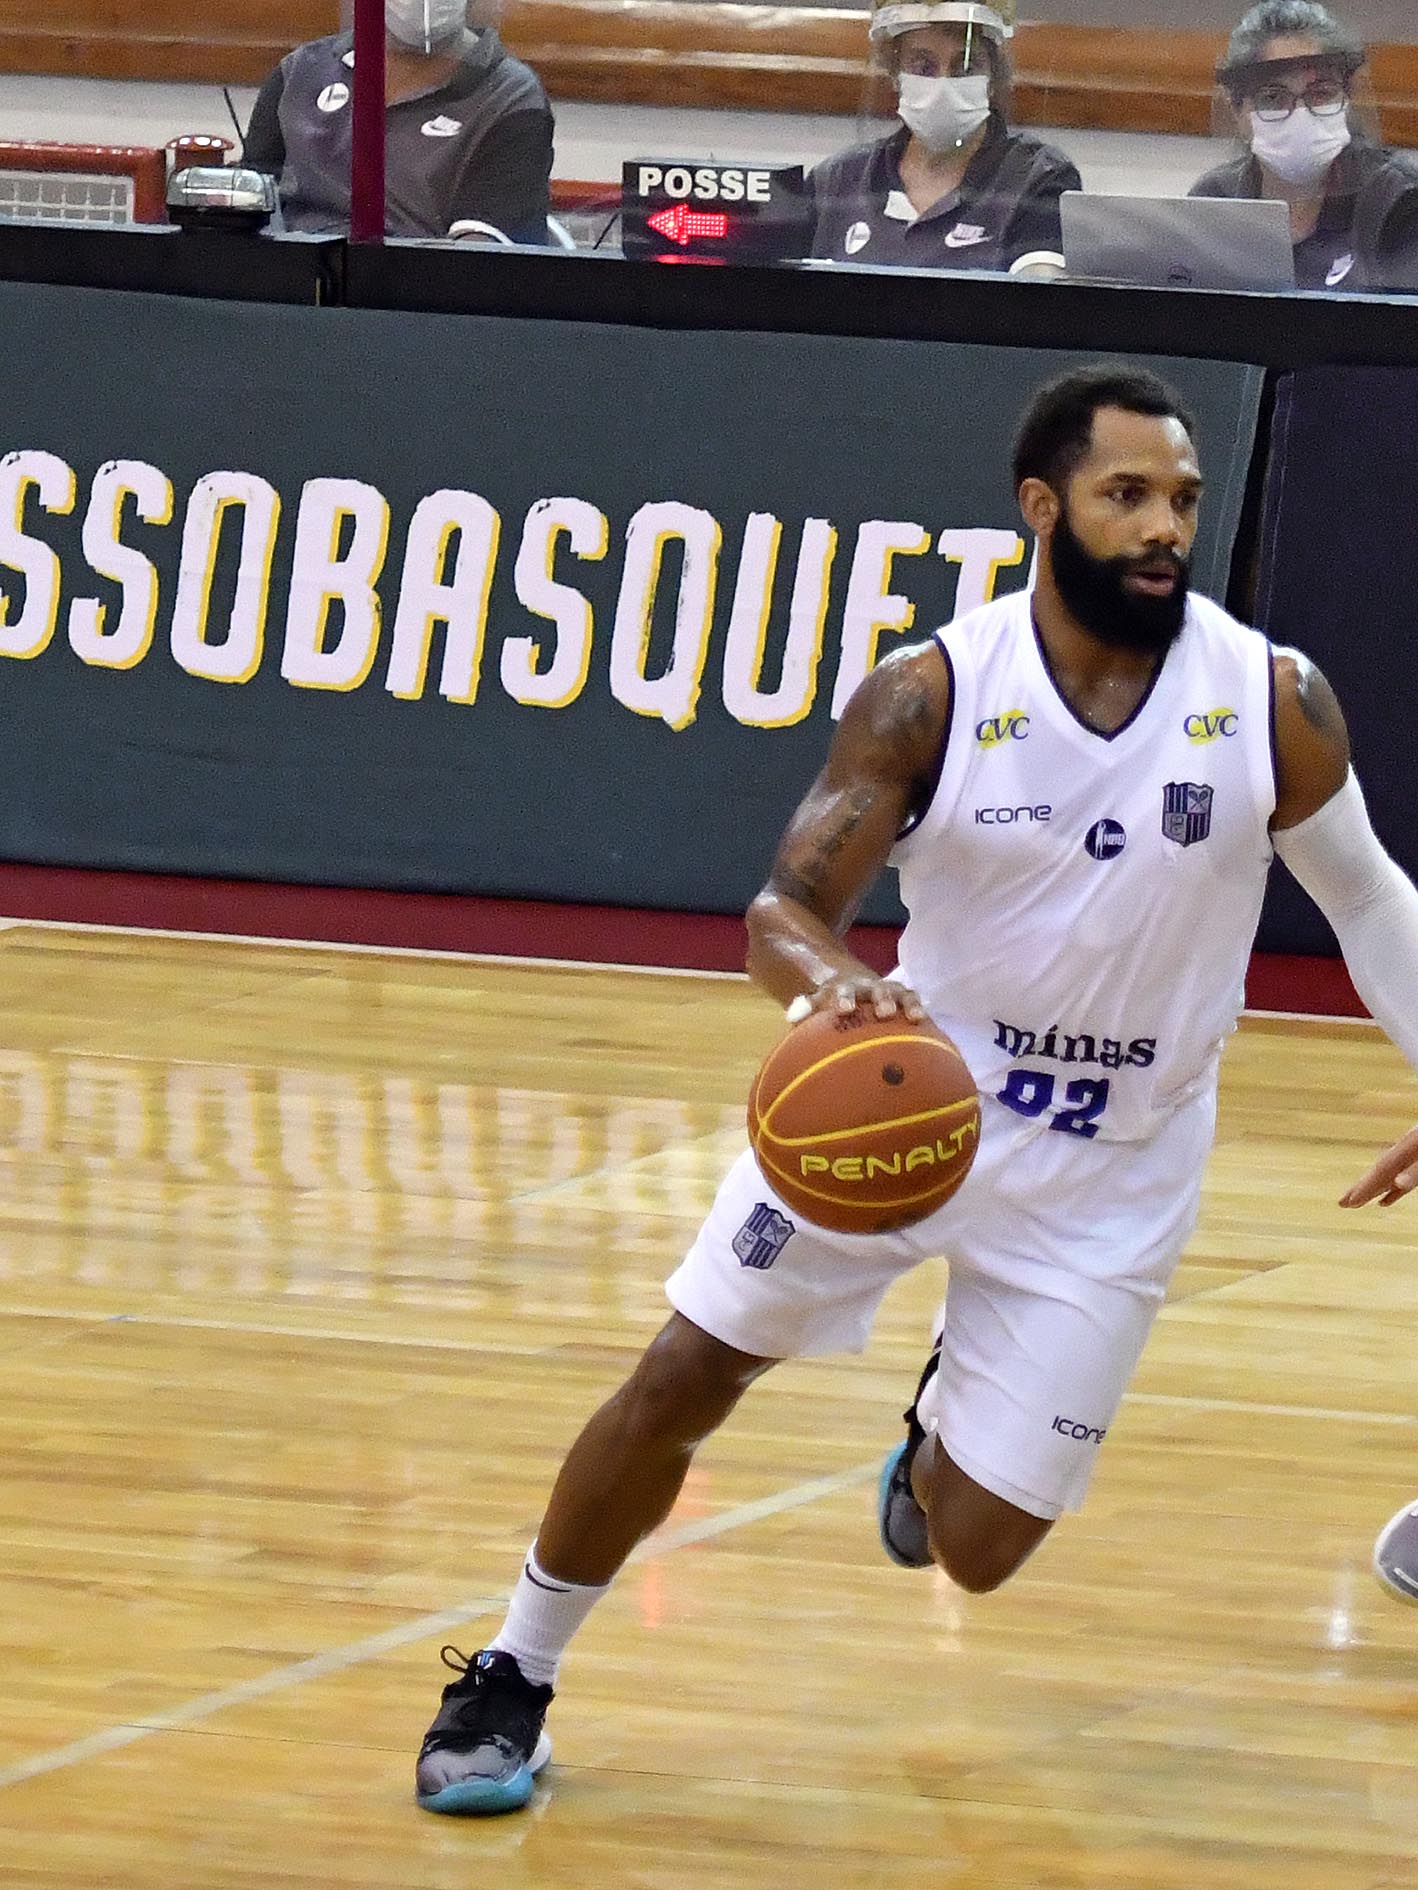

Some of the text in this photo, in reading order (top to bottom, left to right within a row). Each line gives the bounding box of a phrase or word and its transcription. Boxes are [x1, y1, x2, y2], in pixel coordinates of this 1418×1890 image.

[638, 166, 772, 202] POSSE
[0, 449, 1038, 730] SSOBASQUET
[976, 716, 1030, 742] CVC
[1183, 713, 1239, 738] CVC
[992, 1018, 1157, 1071] minas
[800, 1113, 978, 1181] PENALTY
